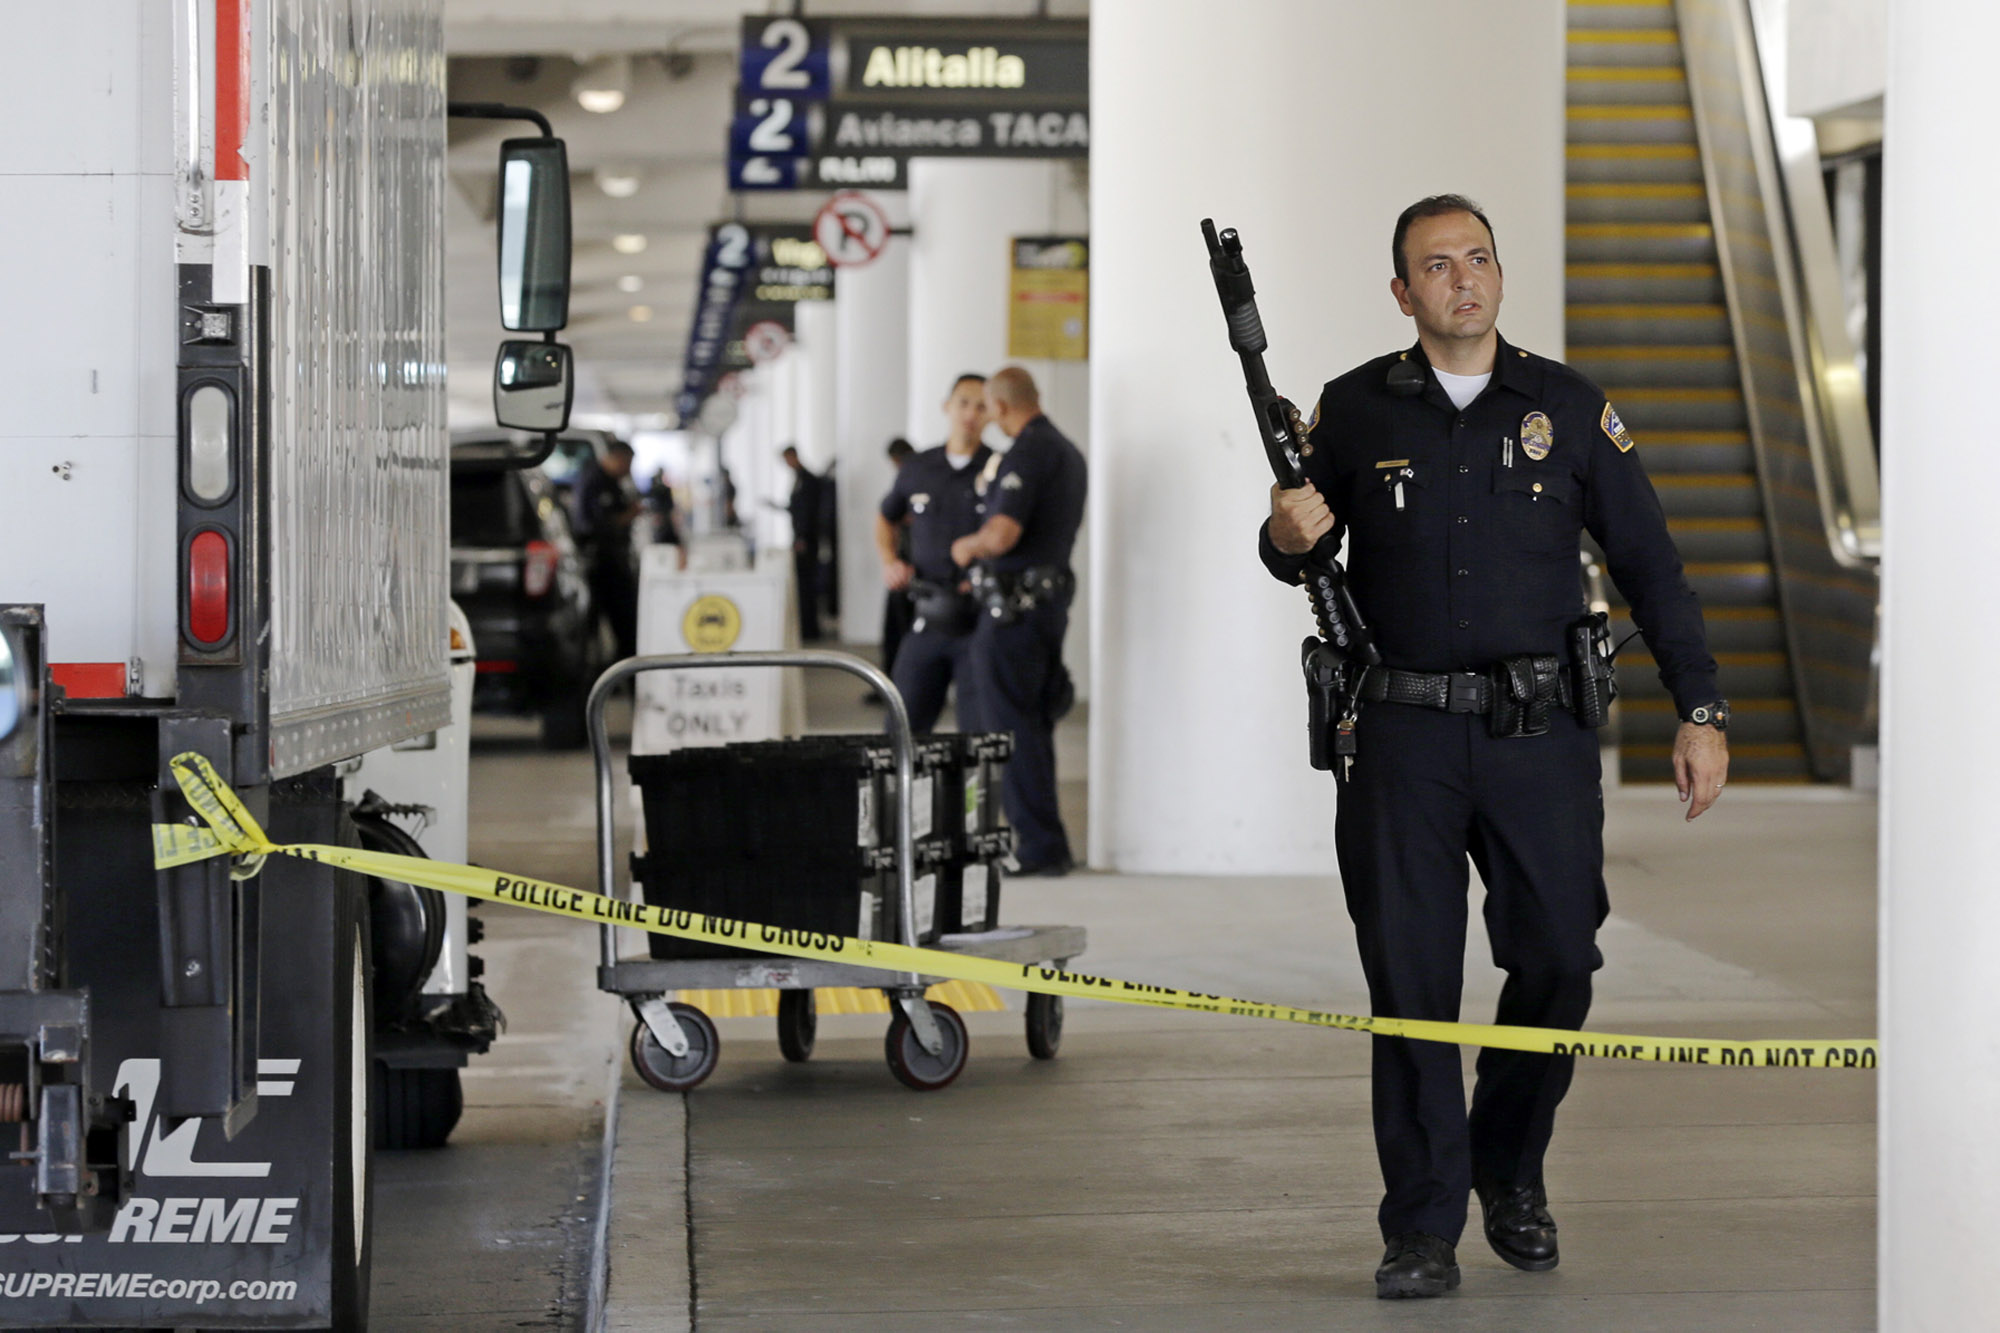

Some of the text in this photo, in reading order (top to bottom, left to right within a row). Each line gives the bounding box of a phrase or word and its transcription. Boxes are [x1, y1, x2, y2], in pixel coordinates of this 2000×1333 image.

[761, 20, 811, 89] 2
[862, 46, 1026, 88] Alitalia
[750, 99, 793, 151] 2
[836, 112, 1089, 147] Avianca TACA
[717, 224, 749, 268] 2
[667, 710, 747, 736] ONLY
[494, 876, 583, 913] POLICE
[594, 896, 648, 924] LINE
